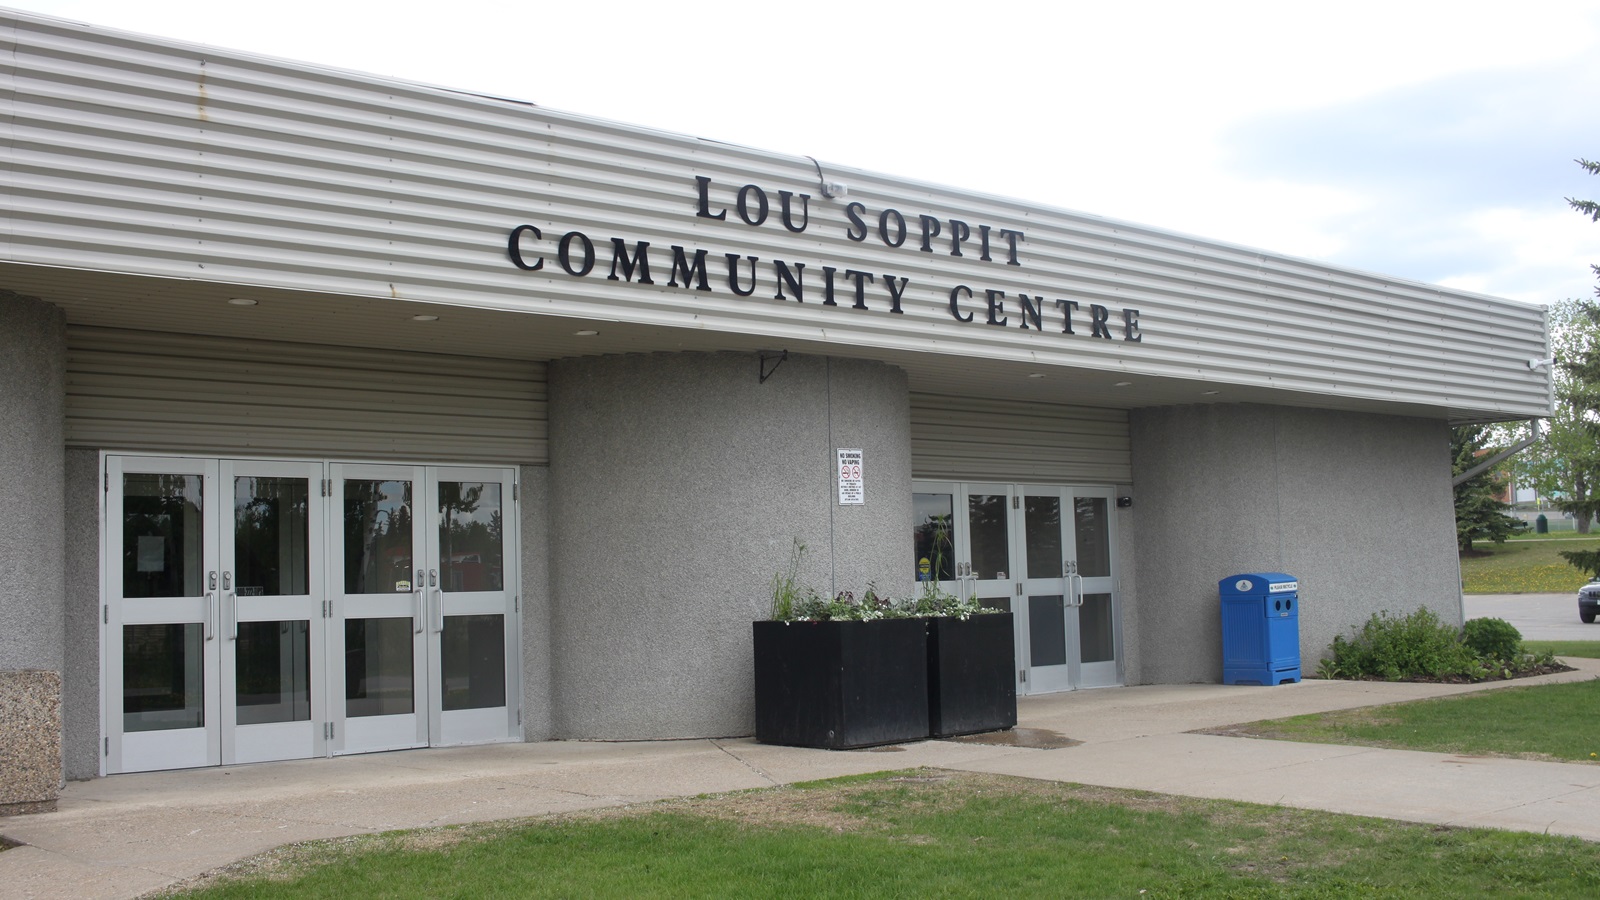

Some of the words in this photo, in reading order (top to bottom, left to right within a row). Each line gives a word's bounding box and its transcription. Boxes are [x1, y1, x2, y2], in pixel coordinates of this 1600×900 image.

[695, 175, 811, 234] LOU
[846, 202, 1025, 268] SOPPIT
[506, 224, 910, 315] COMMUNITY
[949, 285, 1142, 343] CENTRE
